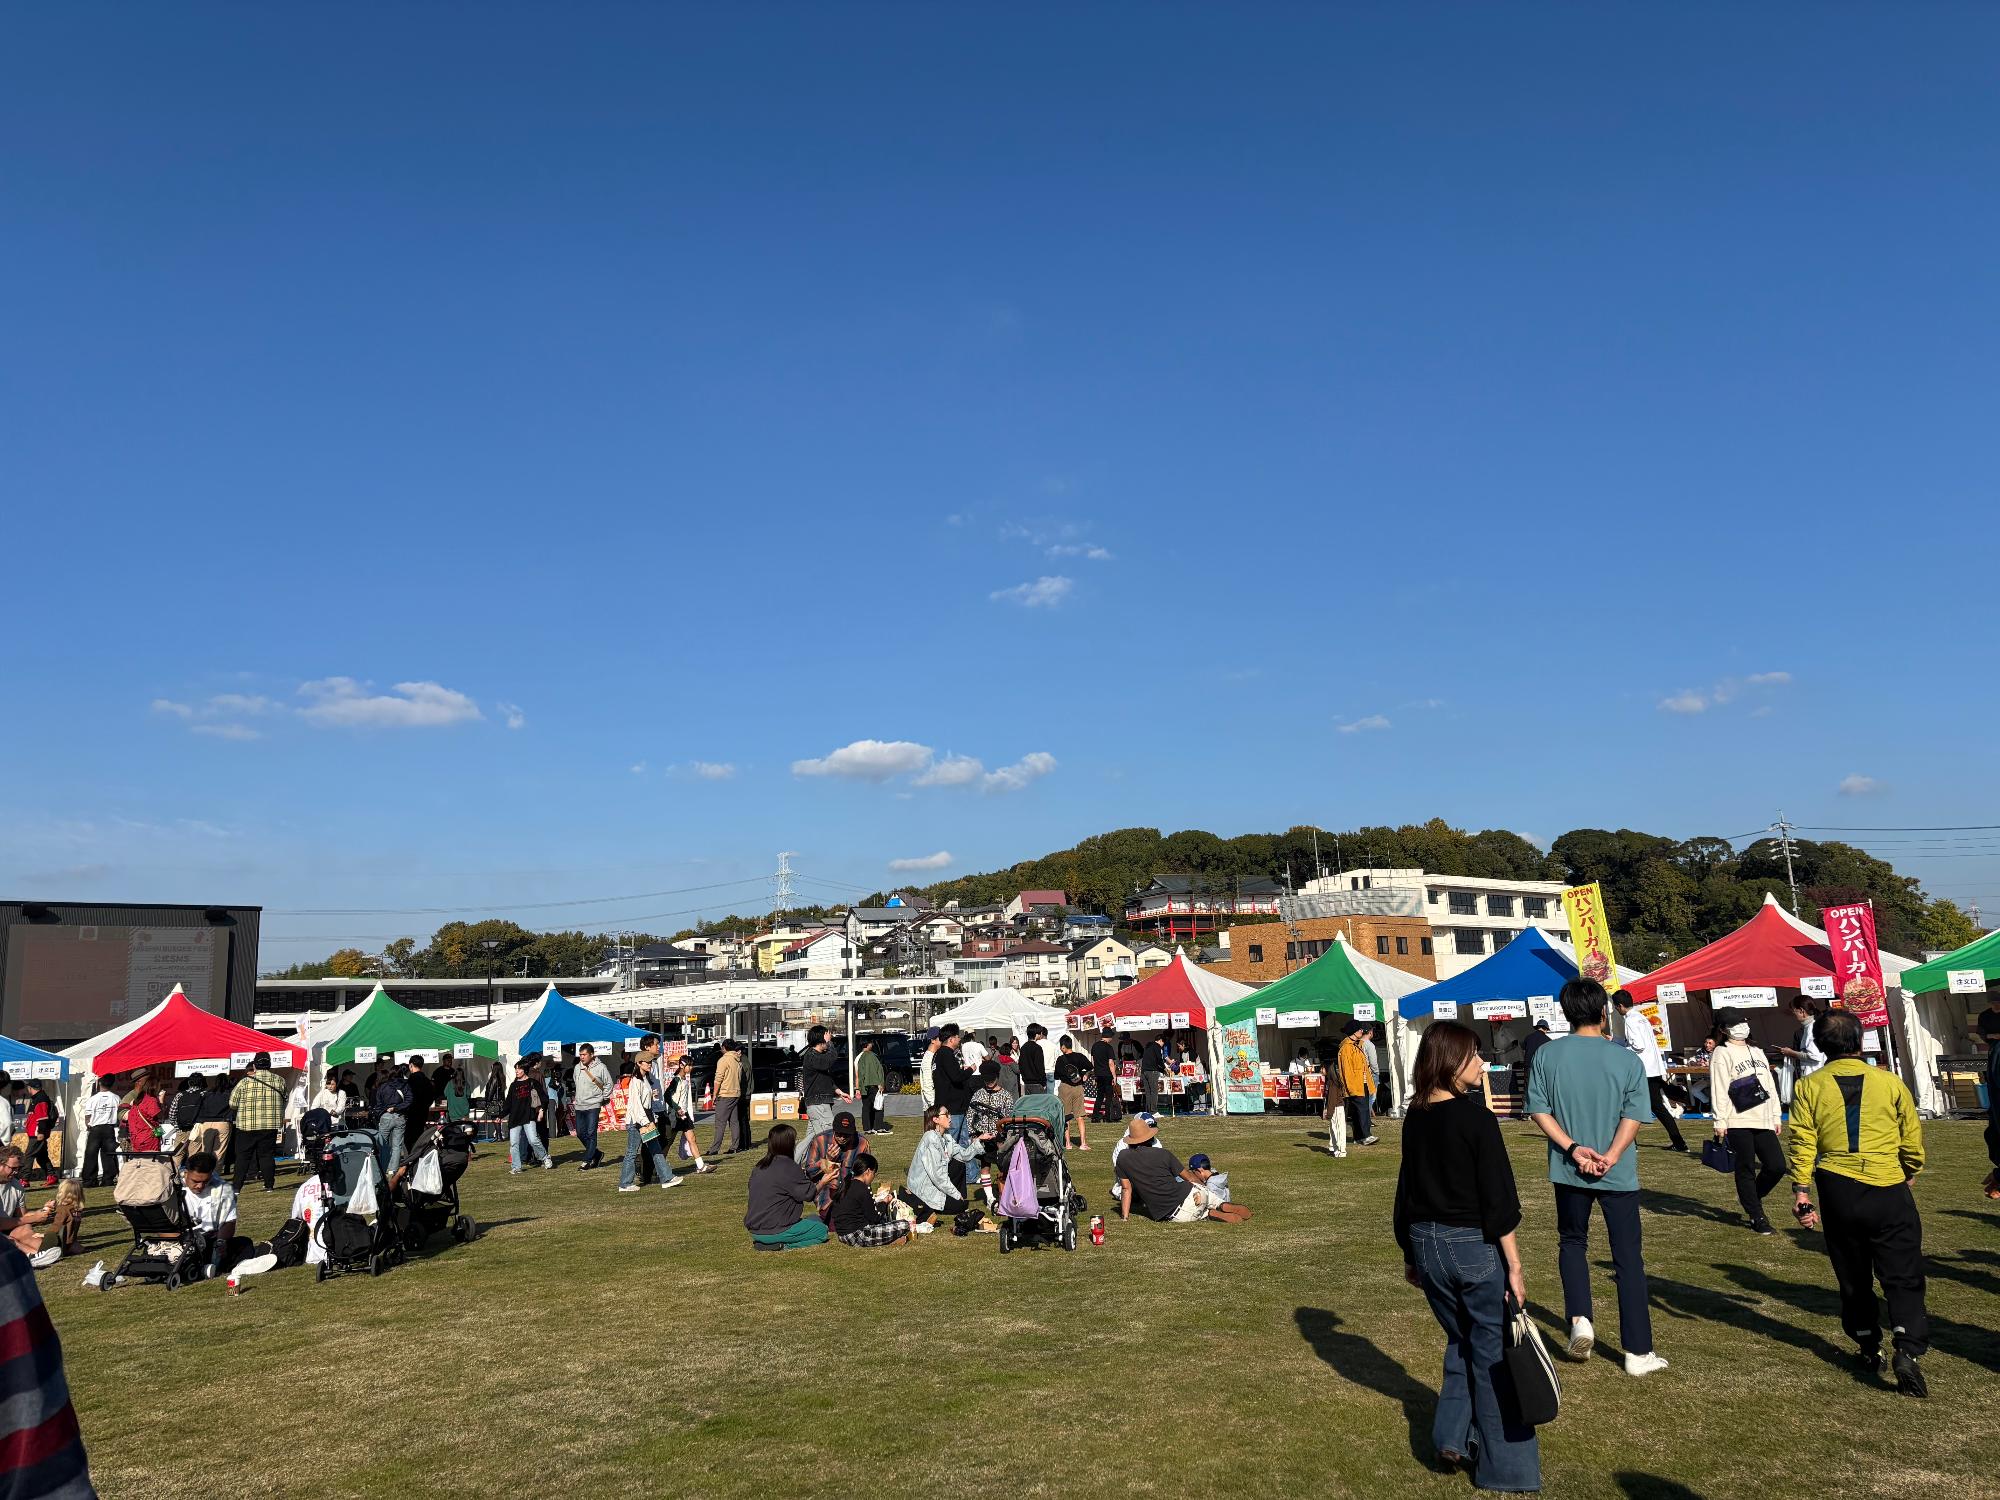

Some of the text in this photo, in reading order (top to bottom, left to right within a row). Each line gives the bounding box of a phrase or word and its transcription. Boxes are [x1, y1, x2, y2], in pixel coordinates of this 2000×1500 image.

[1567, 887, 1593, 899] OPEN
[1576, 898, 1599, 958] ハンバーガー
[1830, 906, 1864, 918] OPEN
[1839, 917, 1868, 983] ハンバーガー
